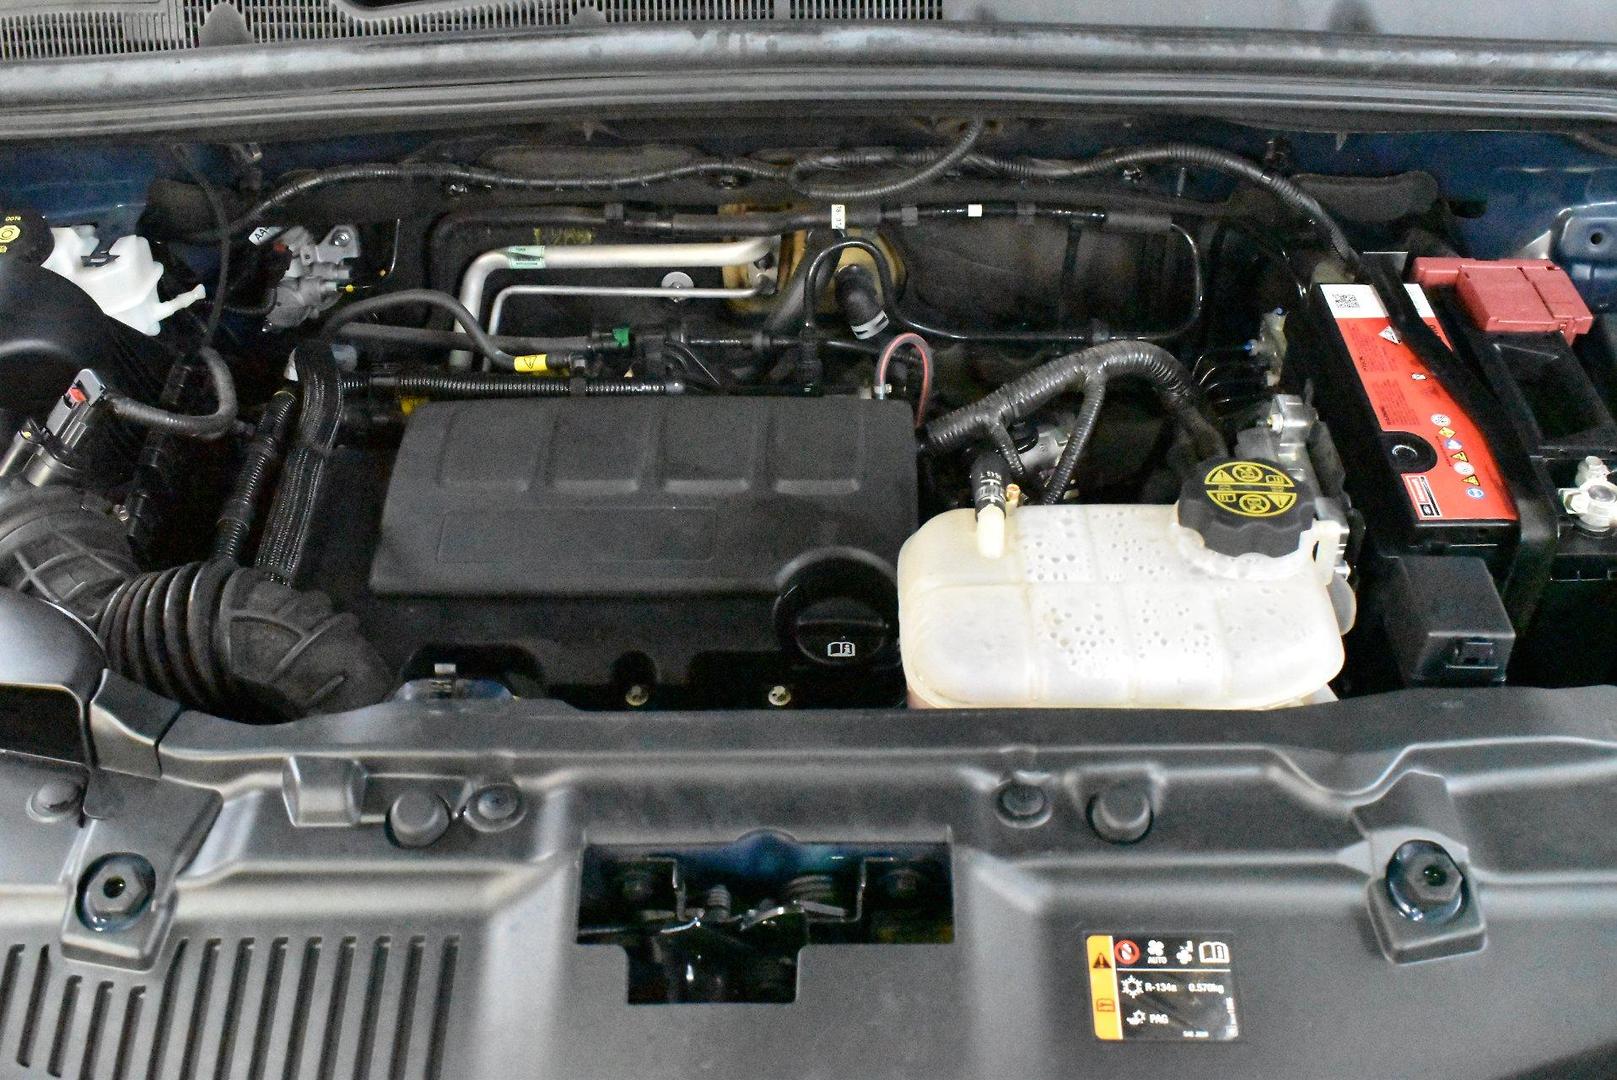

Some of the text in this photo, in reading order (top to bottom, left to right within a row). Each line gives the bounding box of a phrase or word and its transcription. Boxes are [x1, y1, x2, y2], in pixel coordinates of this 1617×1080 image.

[1147, 956, 1168, 964] AUTO
[1144, 982, 1178, 993] R-134a
[1149, 1013, 1169, 1024] PAG
